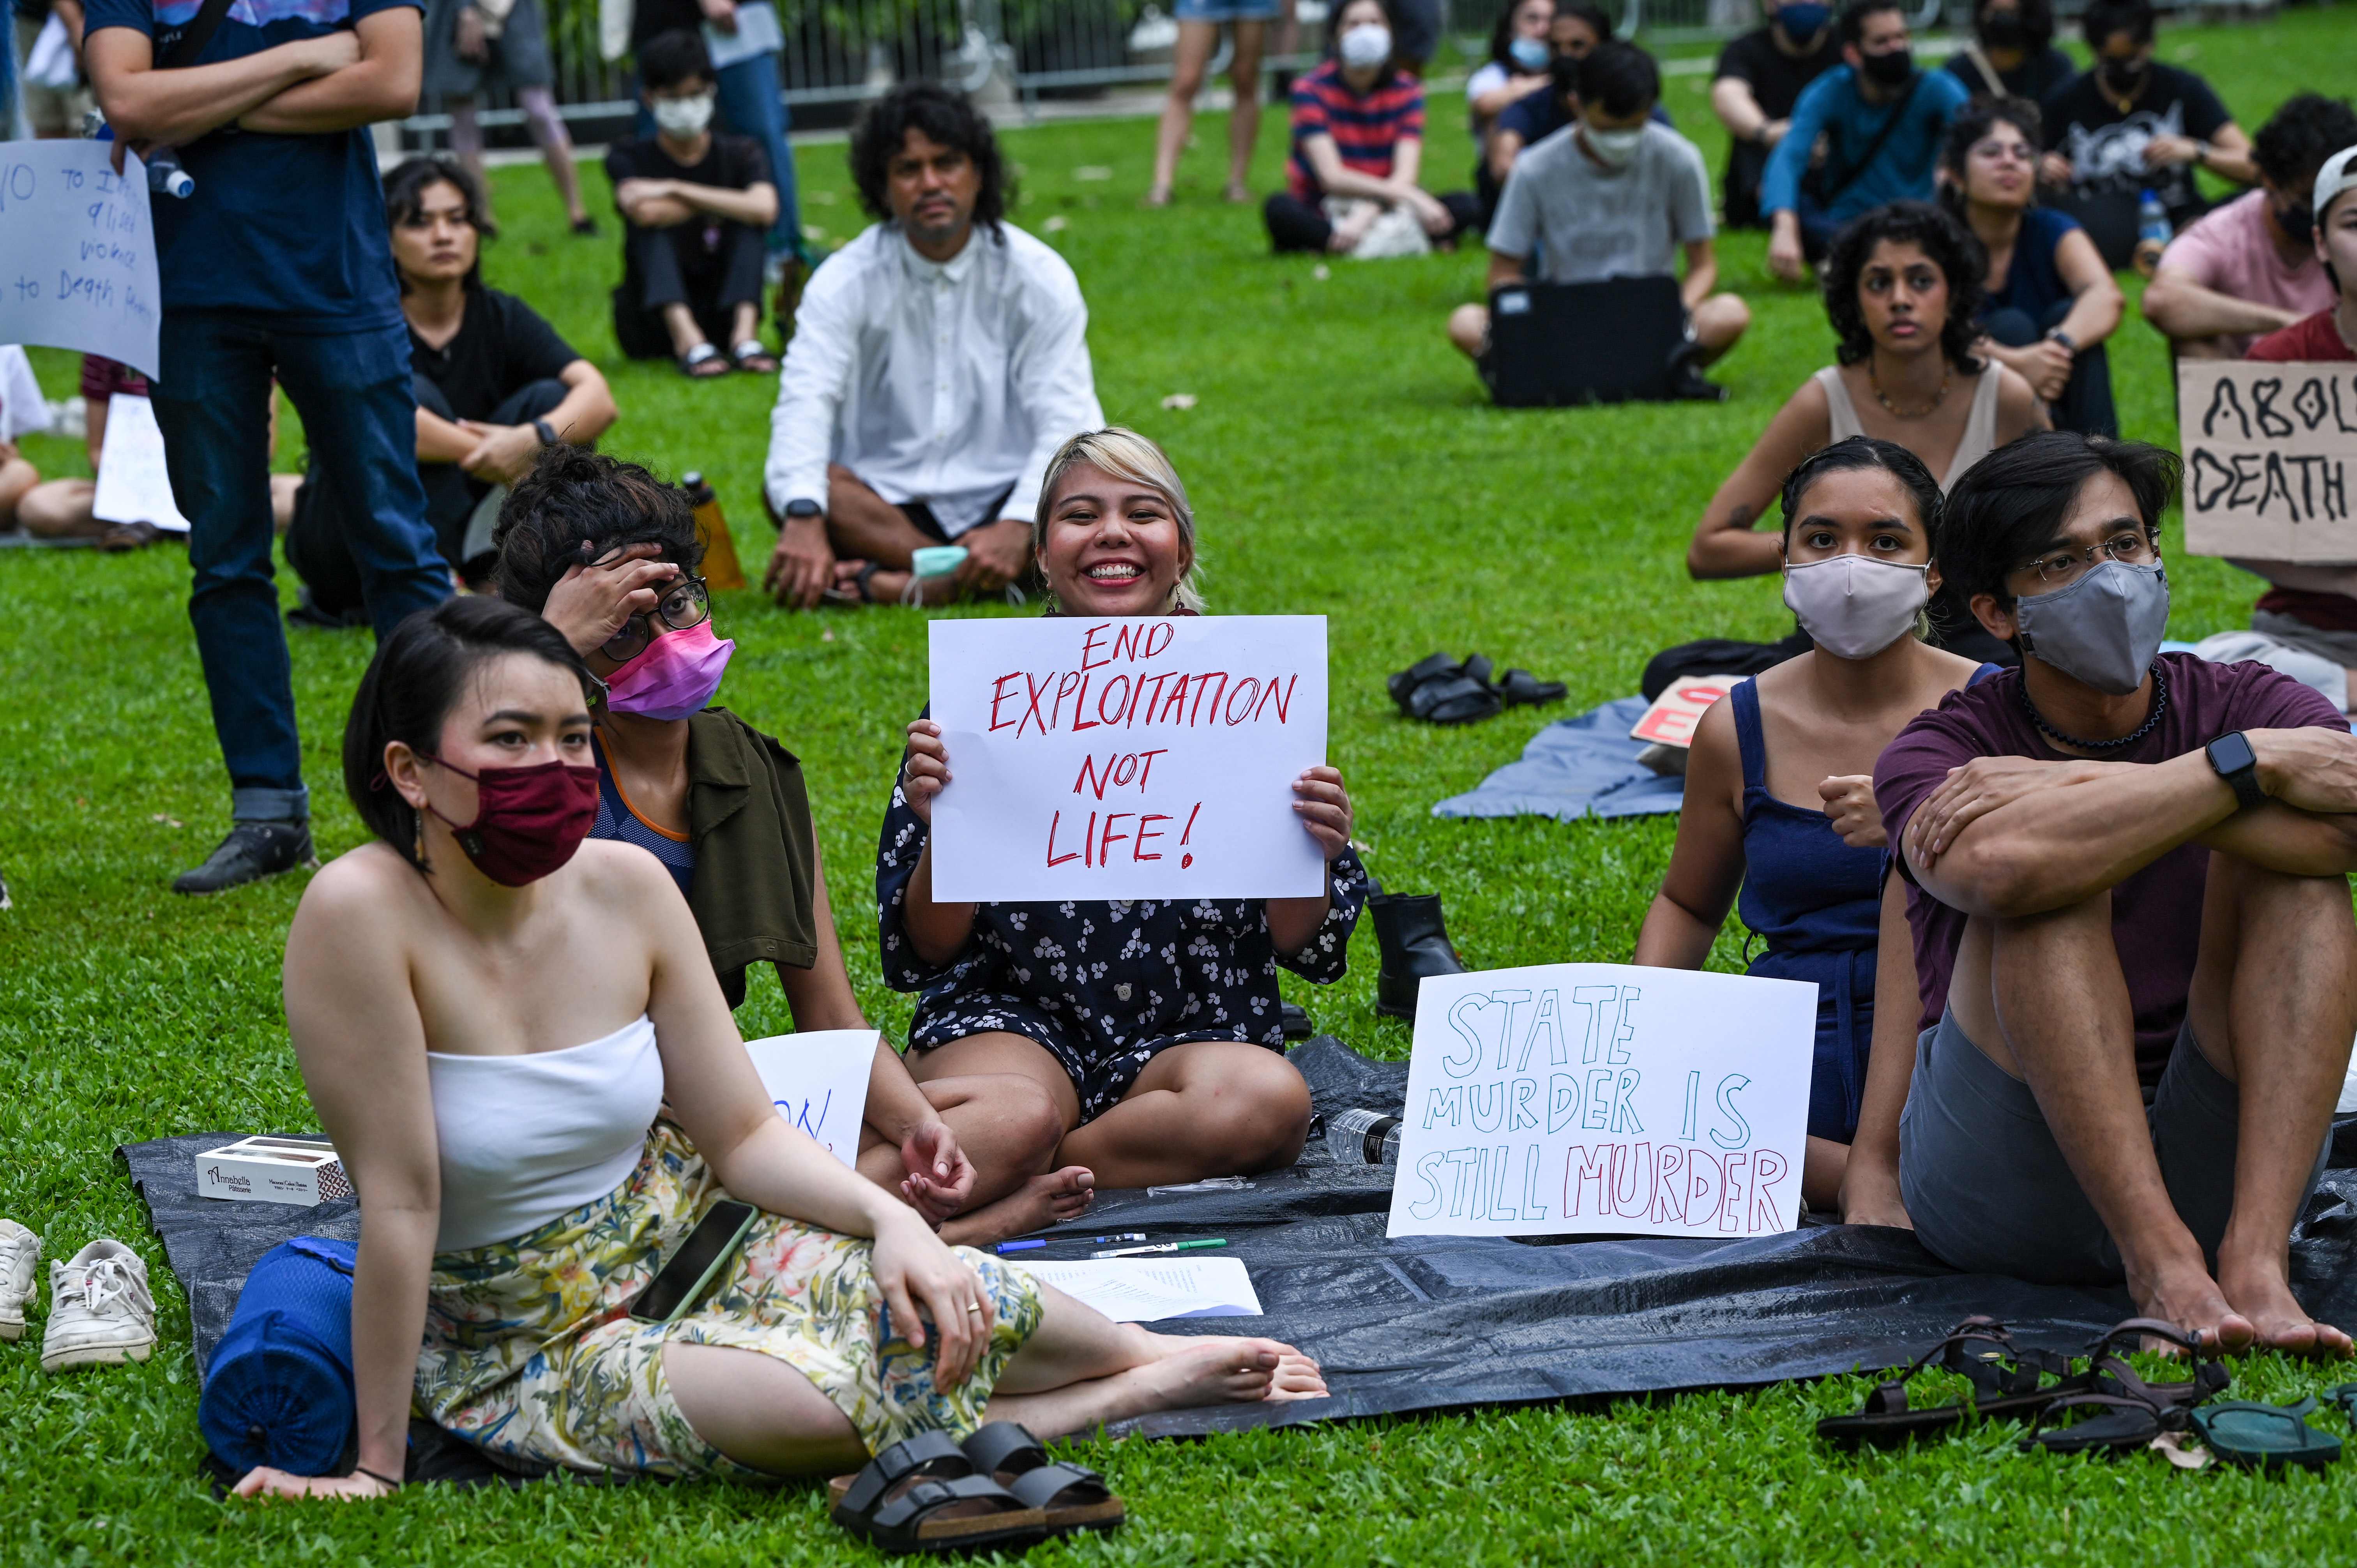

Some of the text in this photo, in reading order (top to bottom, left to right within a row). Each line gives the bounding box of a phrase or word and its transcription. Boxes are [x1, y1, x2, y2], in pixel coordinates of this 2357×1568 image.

[2203, 375, 2357, 439] ABOL
[2191, 447, 2347, 523] DEATH
[1082, 623, 1174, 673] END
[989, 671, 1297, 739] EXPLOITATION
[1073, 749, 1168, 800] NOT
[1047, 801, 1201, 870] LIFE!
[1443, 985, 1641, 1079] STATE
[1422, 1068, 1751, 1150] MURDER IS
[207, 1166, 251, 1186] Annabella
[229, 1185, 251, 1193] Pâtisserie
[1408, 1142, 1788, 1234] STILL MURDER
